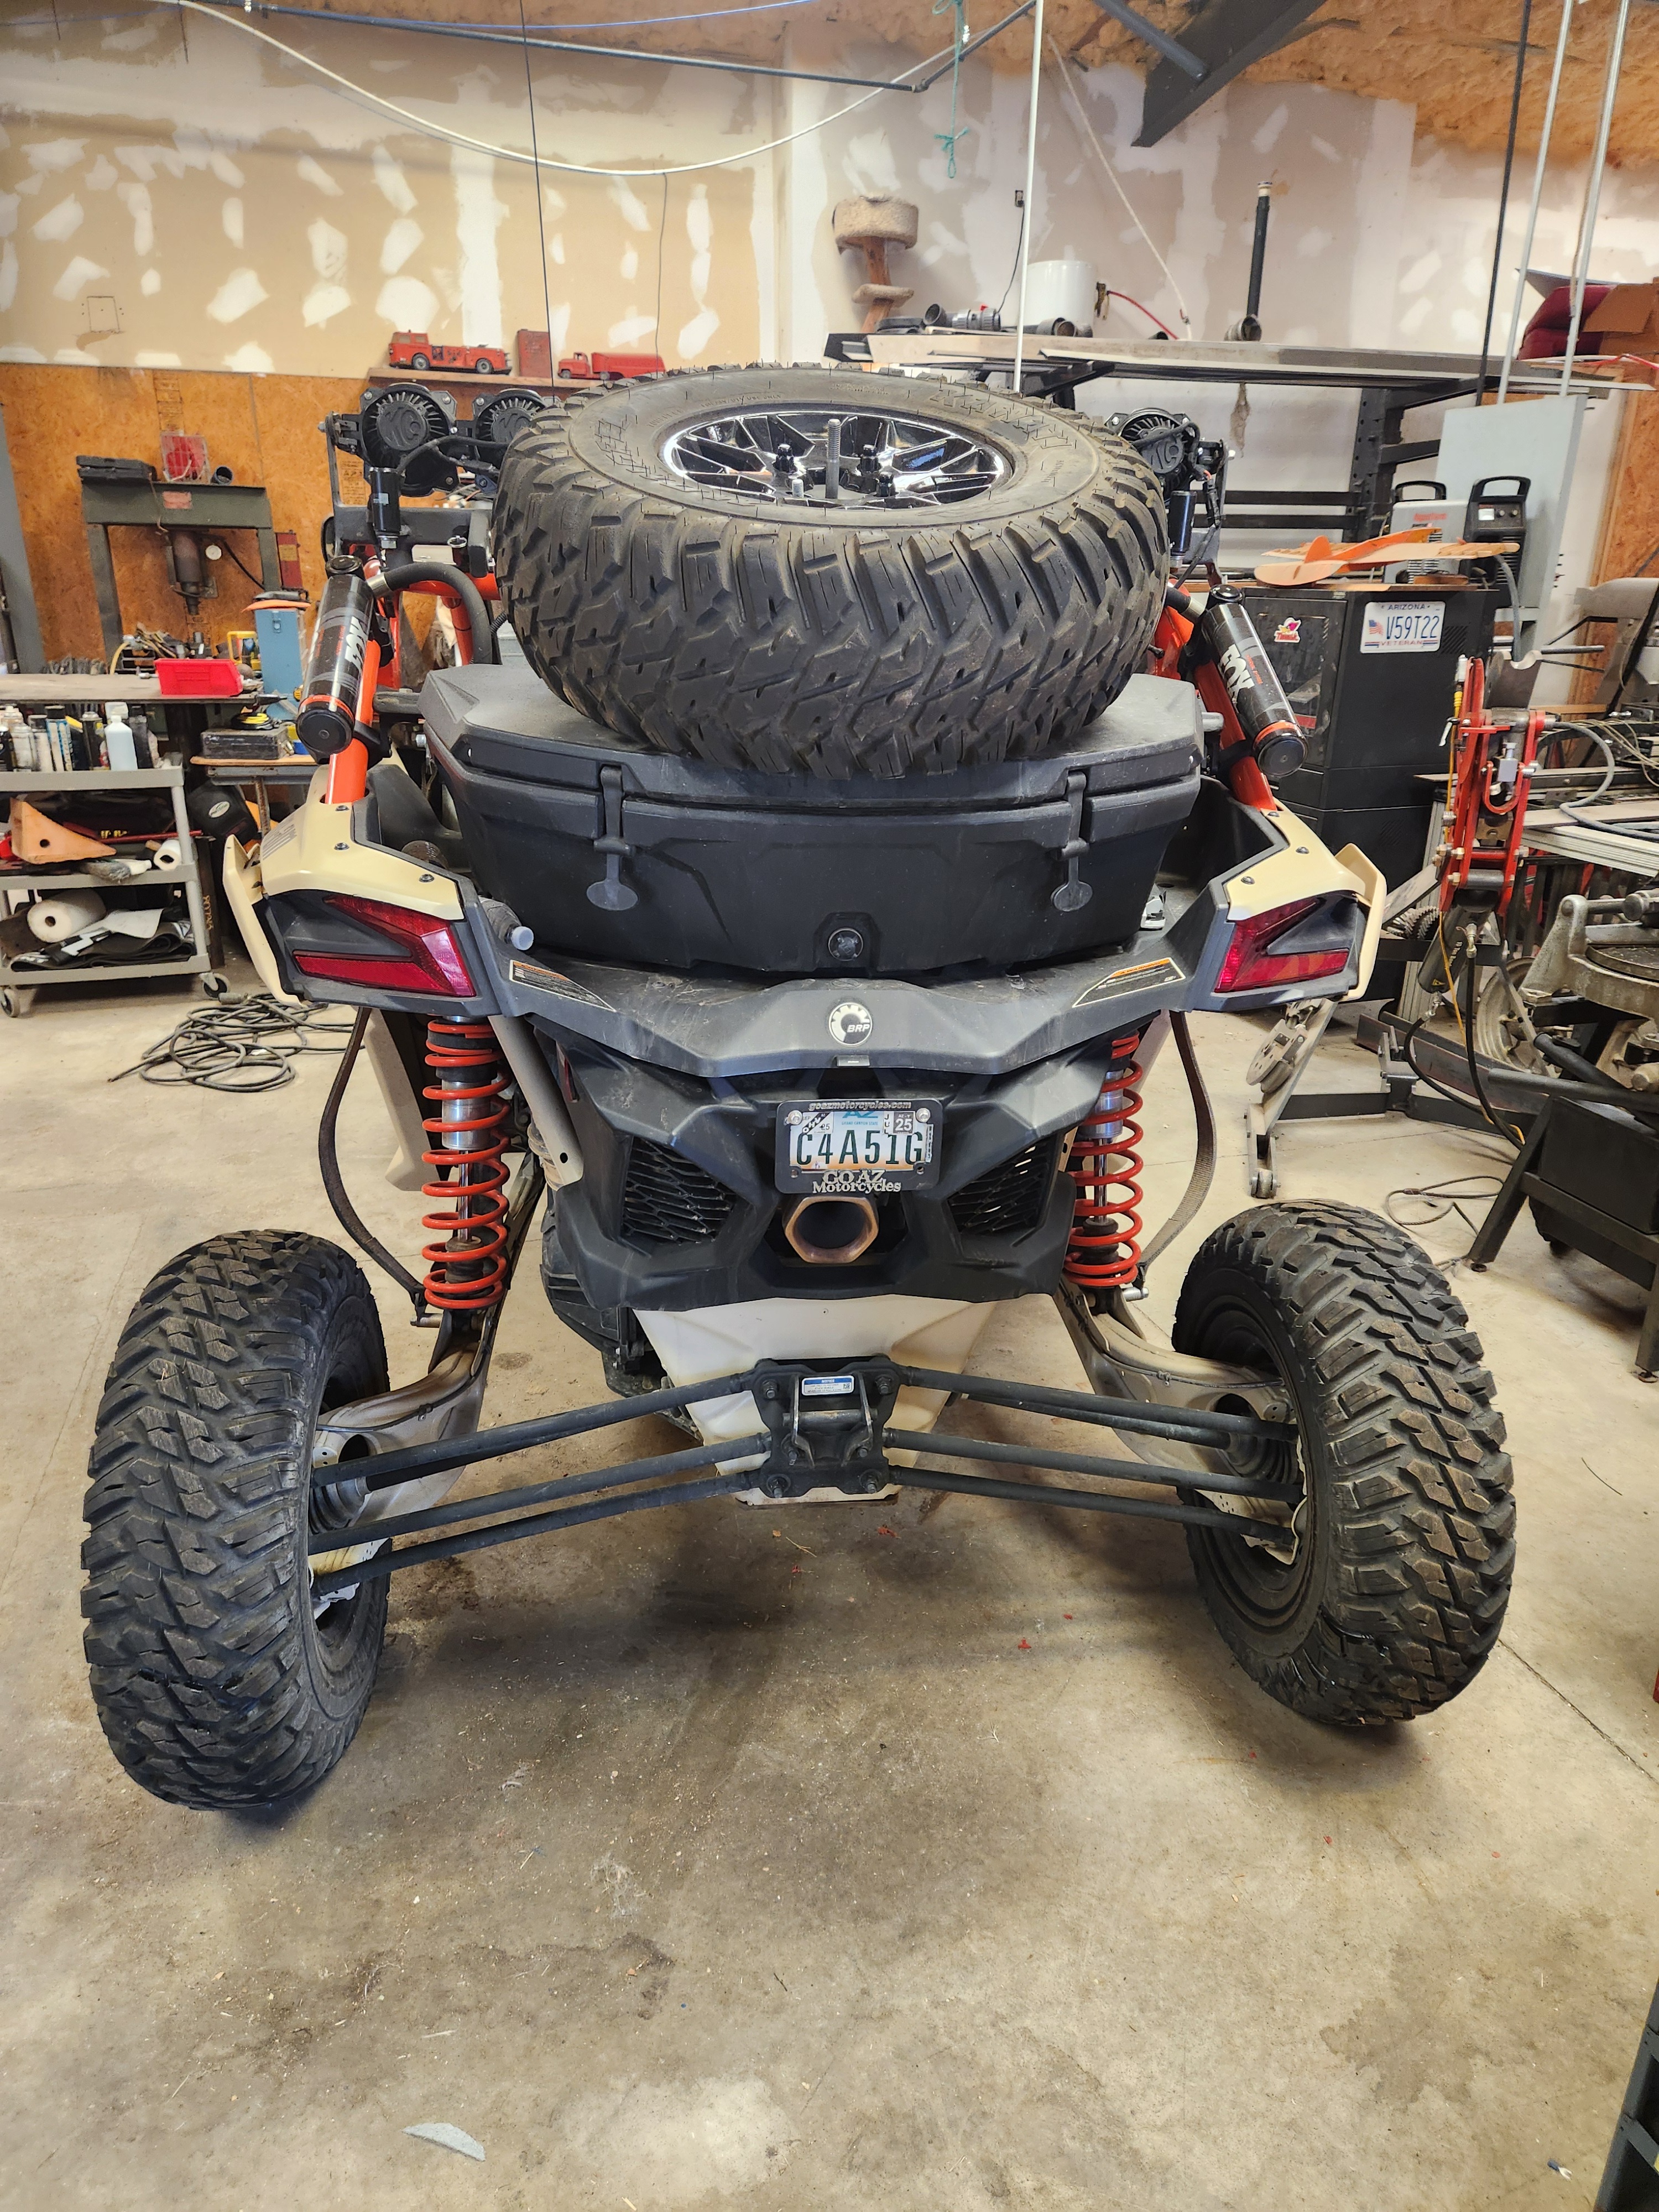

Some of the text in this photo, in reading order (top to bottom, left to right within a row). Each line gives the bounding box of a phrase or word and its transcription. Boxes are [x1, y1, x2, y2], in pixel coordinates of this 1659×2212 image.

[1386, 615, 1440, 640] V59T22
[1218, 643, 1255, 702] FOX
[847, 1024, 870, 1033] BRP
[808, 1100, 911, 1111] goazmotorcycles.com
[895, 1118, 912, 1131] 25
[796, 1129, 923, 1165] C4A51G
[822, 1169, 886, 1185] GO AZ
[812, 1178, 902, 1194] Motorcycles
